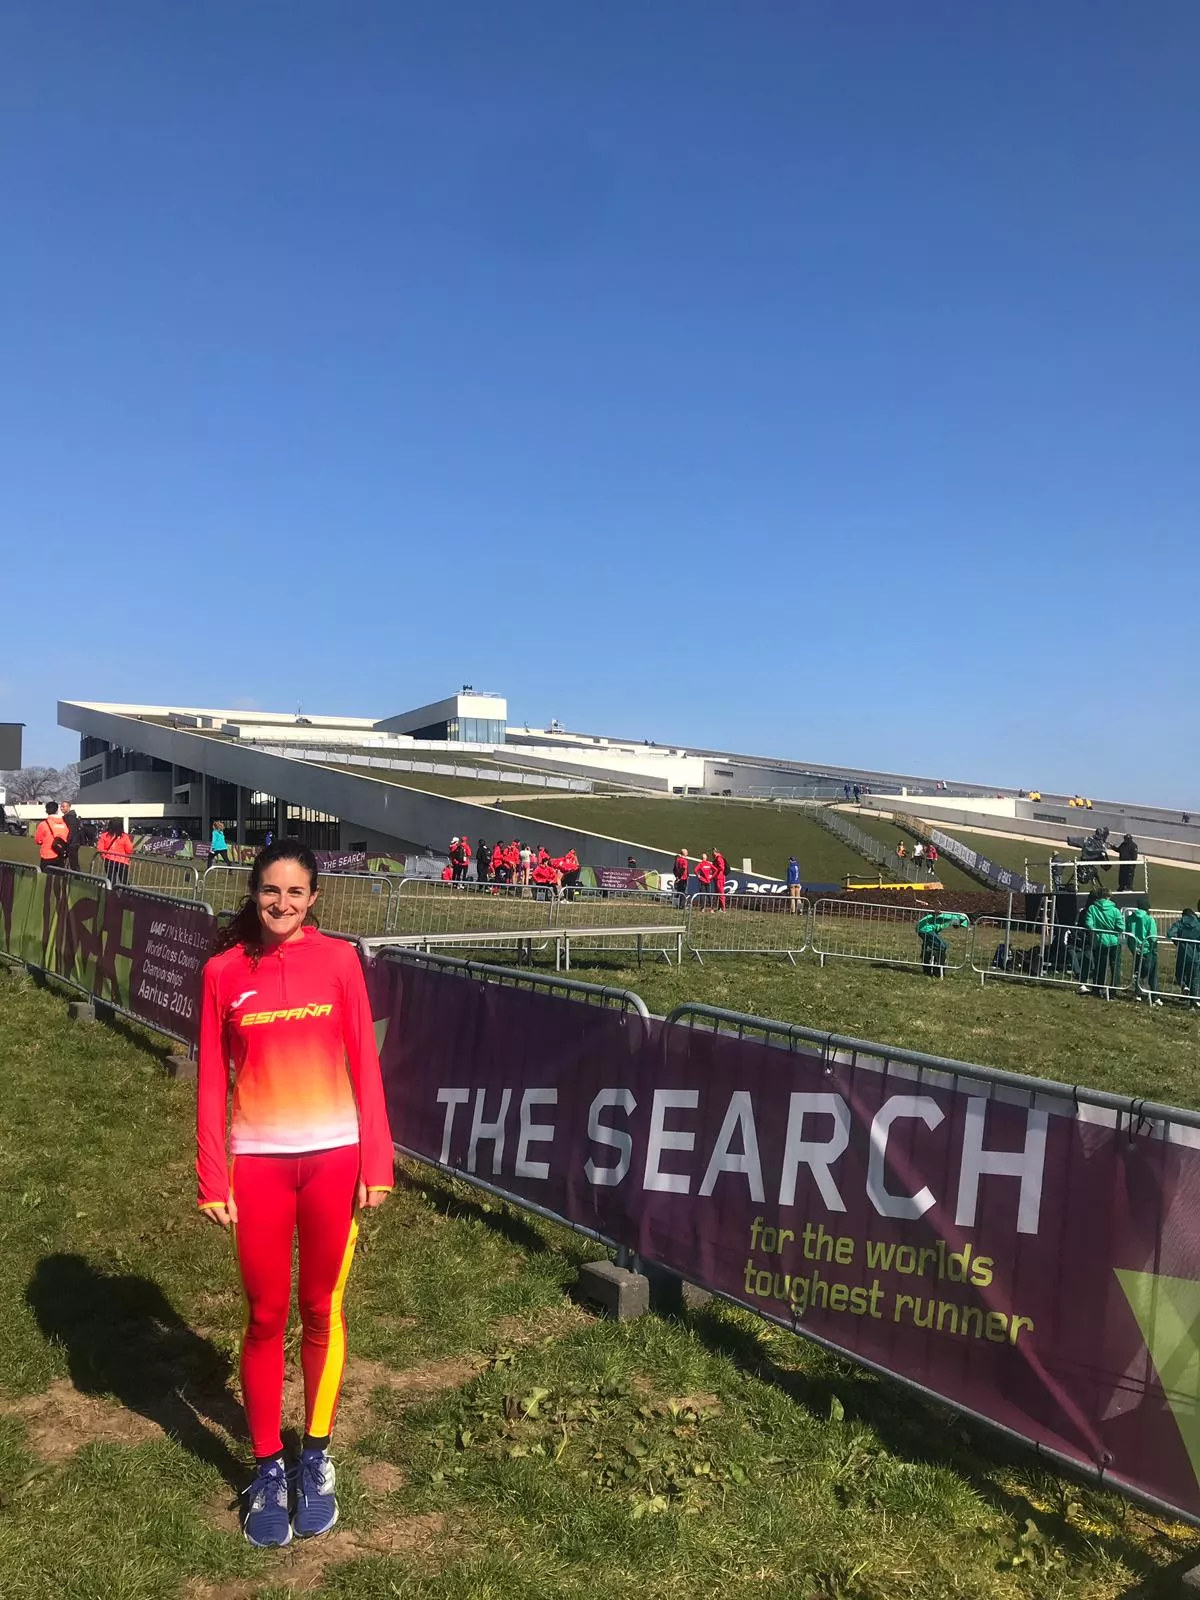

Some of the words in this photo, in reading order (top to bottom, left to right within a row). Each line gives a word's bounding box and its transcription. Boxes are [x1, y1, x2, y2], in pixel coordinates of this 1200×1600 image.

[323, 860, 337, 869] THE
[338, 852, 366, 867] SEARCH
[145, 940, 164, 957] World
[178, 949, 200, 974] Country
[138, 979, 169, 1007] Aarhus
[169, 991, 194, 1018] 2019
[240, 1003, 333, 1026] ESPAÑA
[436, 1088, 558, 1179] THE
[584, 1088, 1049, 1235] SEARCH
[750, 1216, 794, 1255] for
[802, 1221, 855, 1265] the
[865, 1239, 995, 1288] worlds
[743, 1259, 885, 1316] toughest
[895, 1293, 1034, 1346] runner
